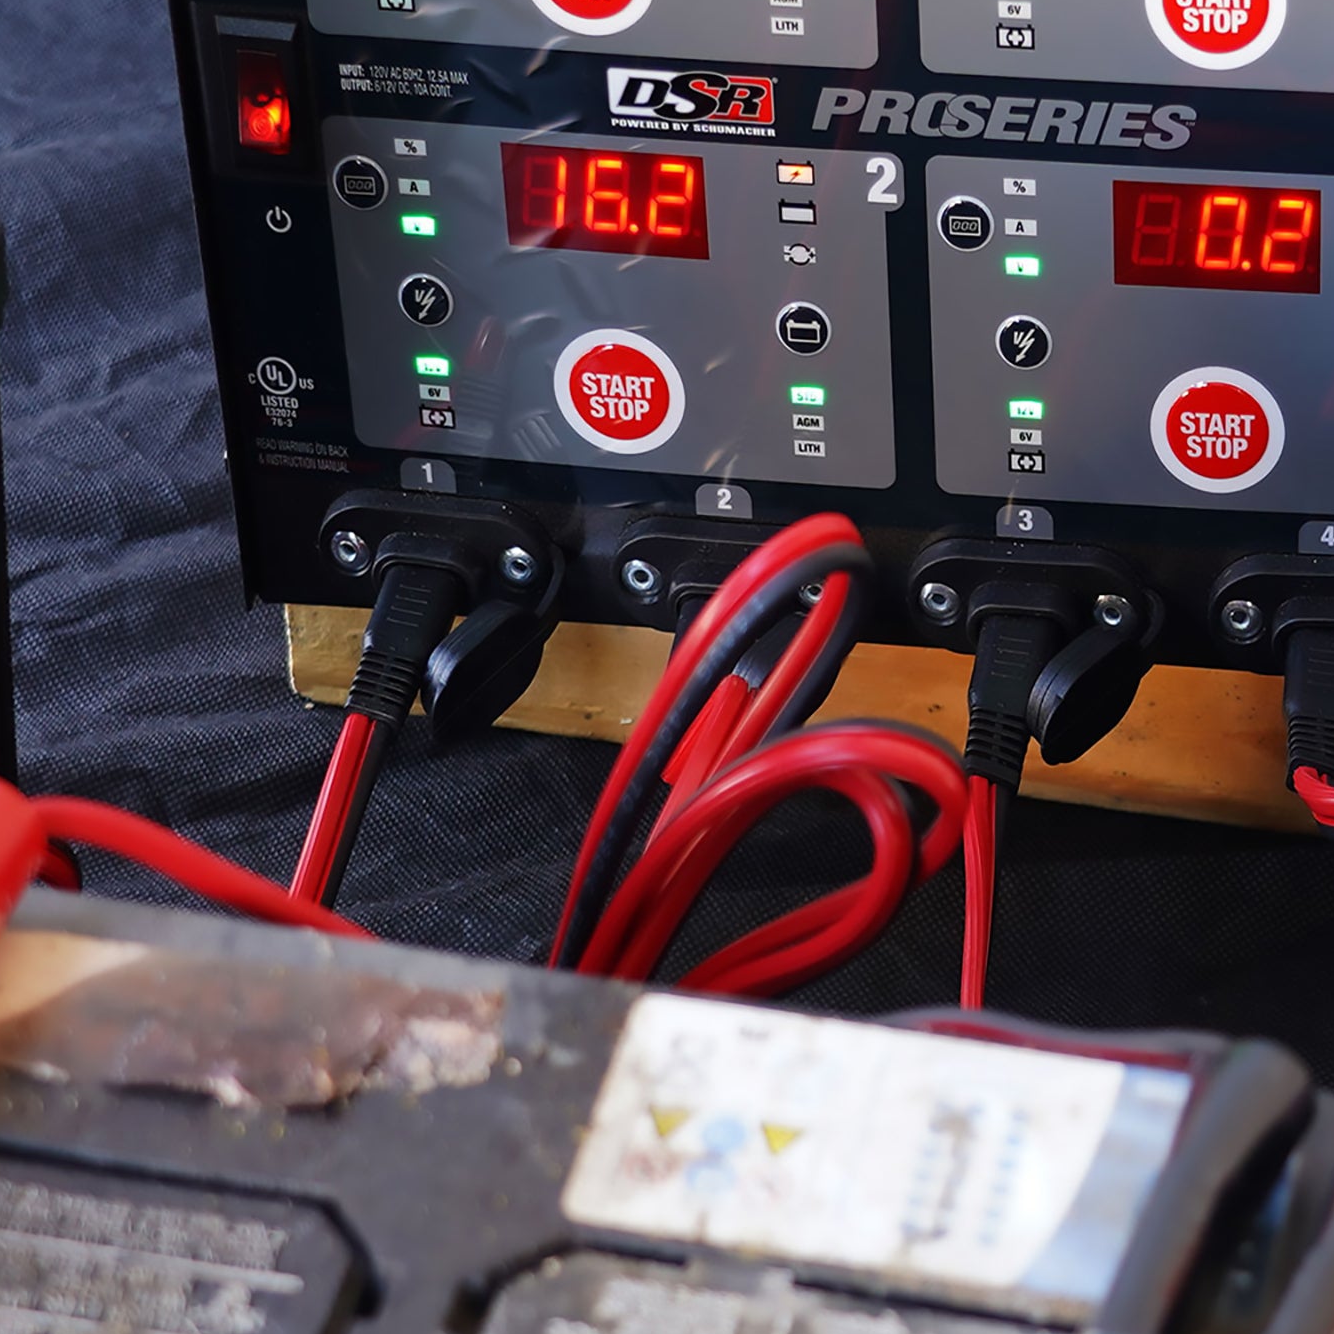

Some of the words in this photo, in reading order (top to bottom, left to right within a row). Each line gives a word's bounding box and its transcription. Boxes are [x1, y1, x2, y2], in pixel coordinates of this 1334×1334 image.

[1008, 5, 1021, 16] 6V
[1182, 7, 1247, 33] STOP
[775, 21, 799, 32] LITH
[338, 64, 364, 77] INPUT:
[390, 68, 401, 80] AC
[450, 71, 469, 85] MAX
[340, 78, 373, 92] OUTPUT:
[617, 71, 768, 122] DSR
[611, 118, 669, 130] POWERED
[672, 122, 689, 132] BY
[693, 124, 776, 137] SCHUMACHER
[403, 141, 417, 154] %
[409, 181, 418, 193] A
[867, 158, 898, 204] 2
[1013, 181, 1026, 193] %
[555, 155, 694, 236] 16.2
[1015, 221, 1025, 234] A
[1197, 196, 1313, 273] 0.2
[265, 364, 288, 387] UL
[299, 378, 315, 390] US
[581, 372, 654, 398] START
[261, 395, 299, 409] LISTED
[428, 387, 441, 398] 6V
[589, 397, 650, 421] STOP
[796, 417, 820, 427] AGM
[1180, 412, 1255, 437] START
[1019, 431, 1033, 442] 6V
[798, 443, 821, 453] LITH
[1187, 436, 1247, 460] STOP
[421, 462, 433, 483] 1
[716, 489, 733, 510] 2
[1018, 510, 1033, 532] 3
